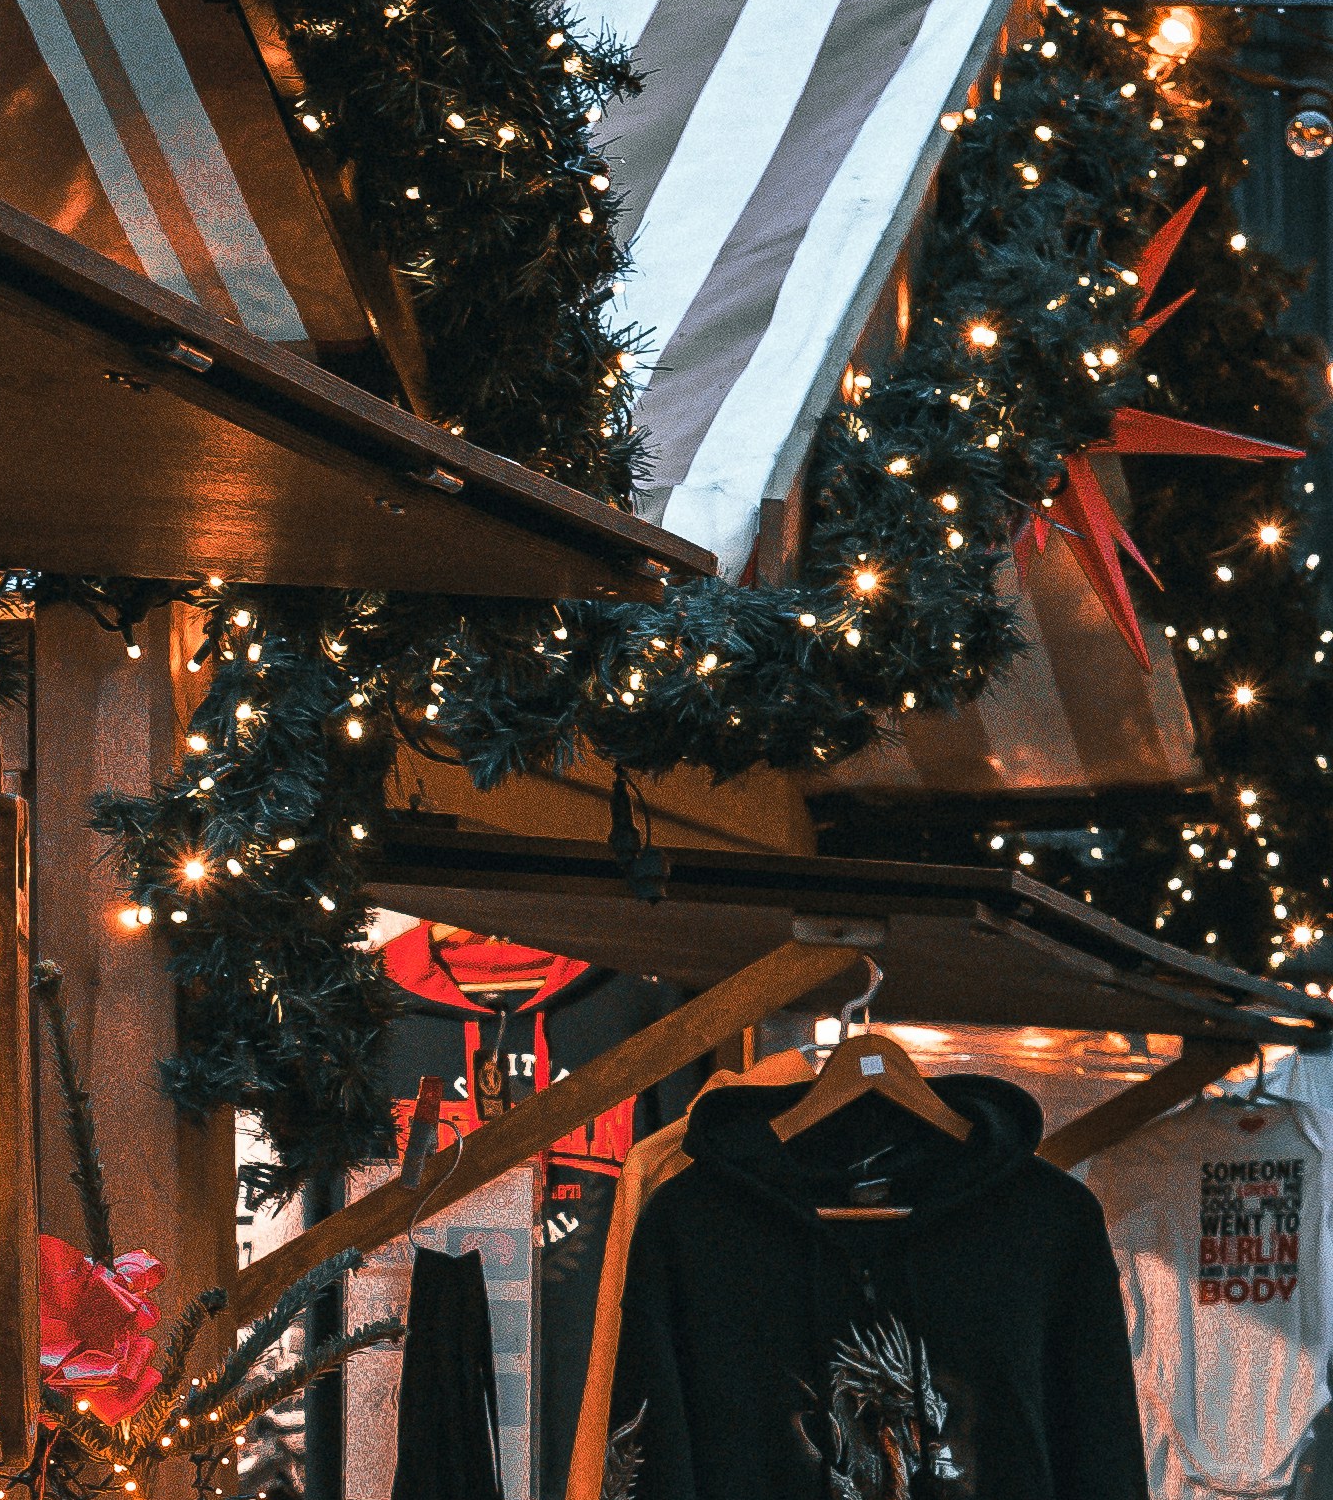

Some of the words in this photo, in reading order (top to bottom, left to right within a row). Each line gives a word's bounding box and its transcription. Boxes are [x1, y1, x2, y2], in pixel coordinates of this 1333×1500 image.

[1201, 1159, 1304, 1181] SOMEONE
[1200, 1213, 1262, 1235] WENT
[1275, 1212, 1300, 1233] TO
[1199, 1277, 1298, 1305] BODY
